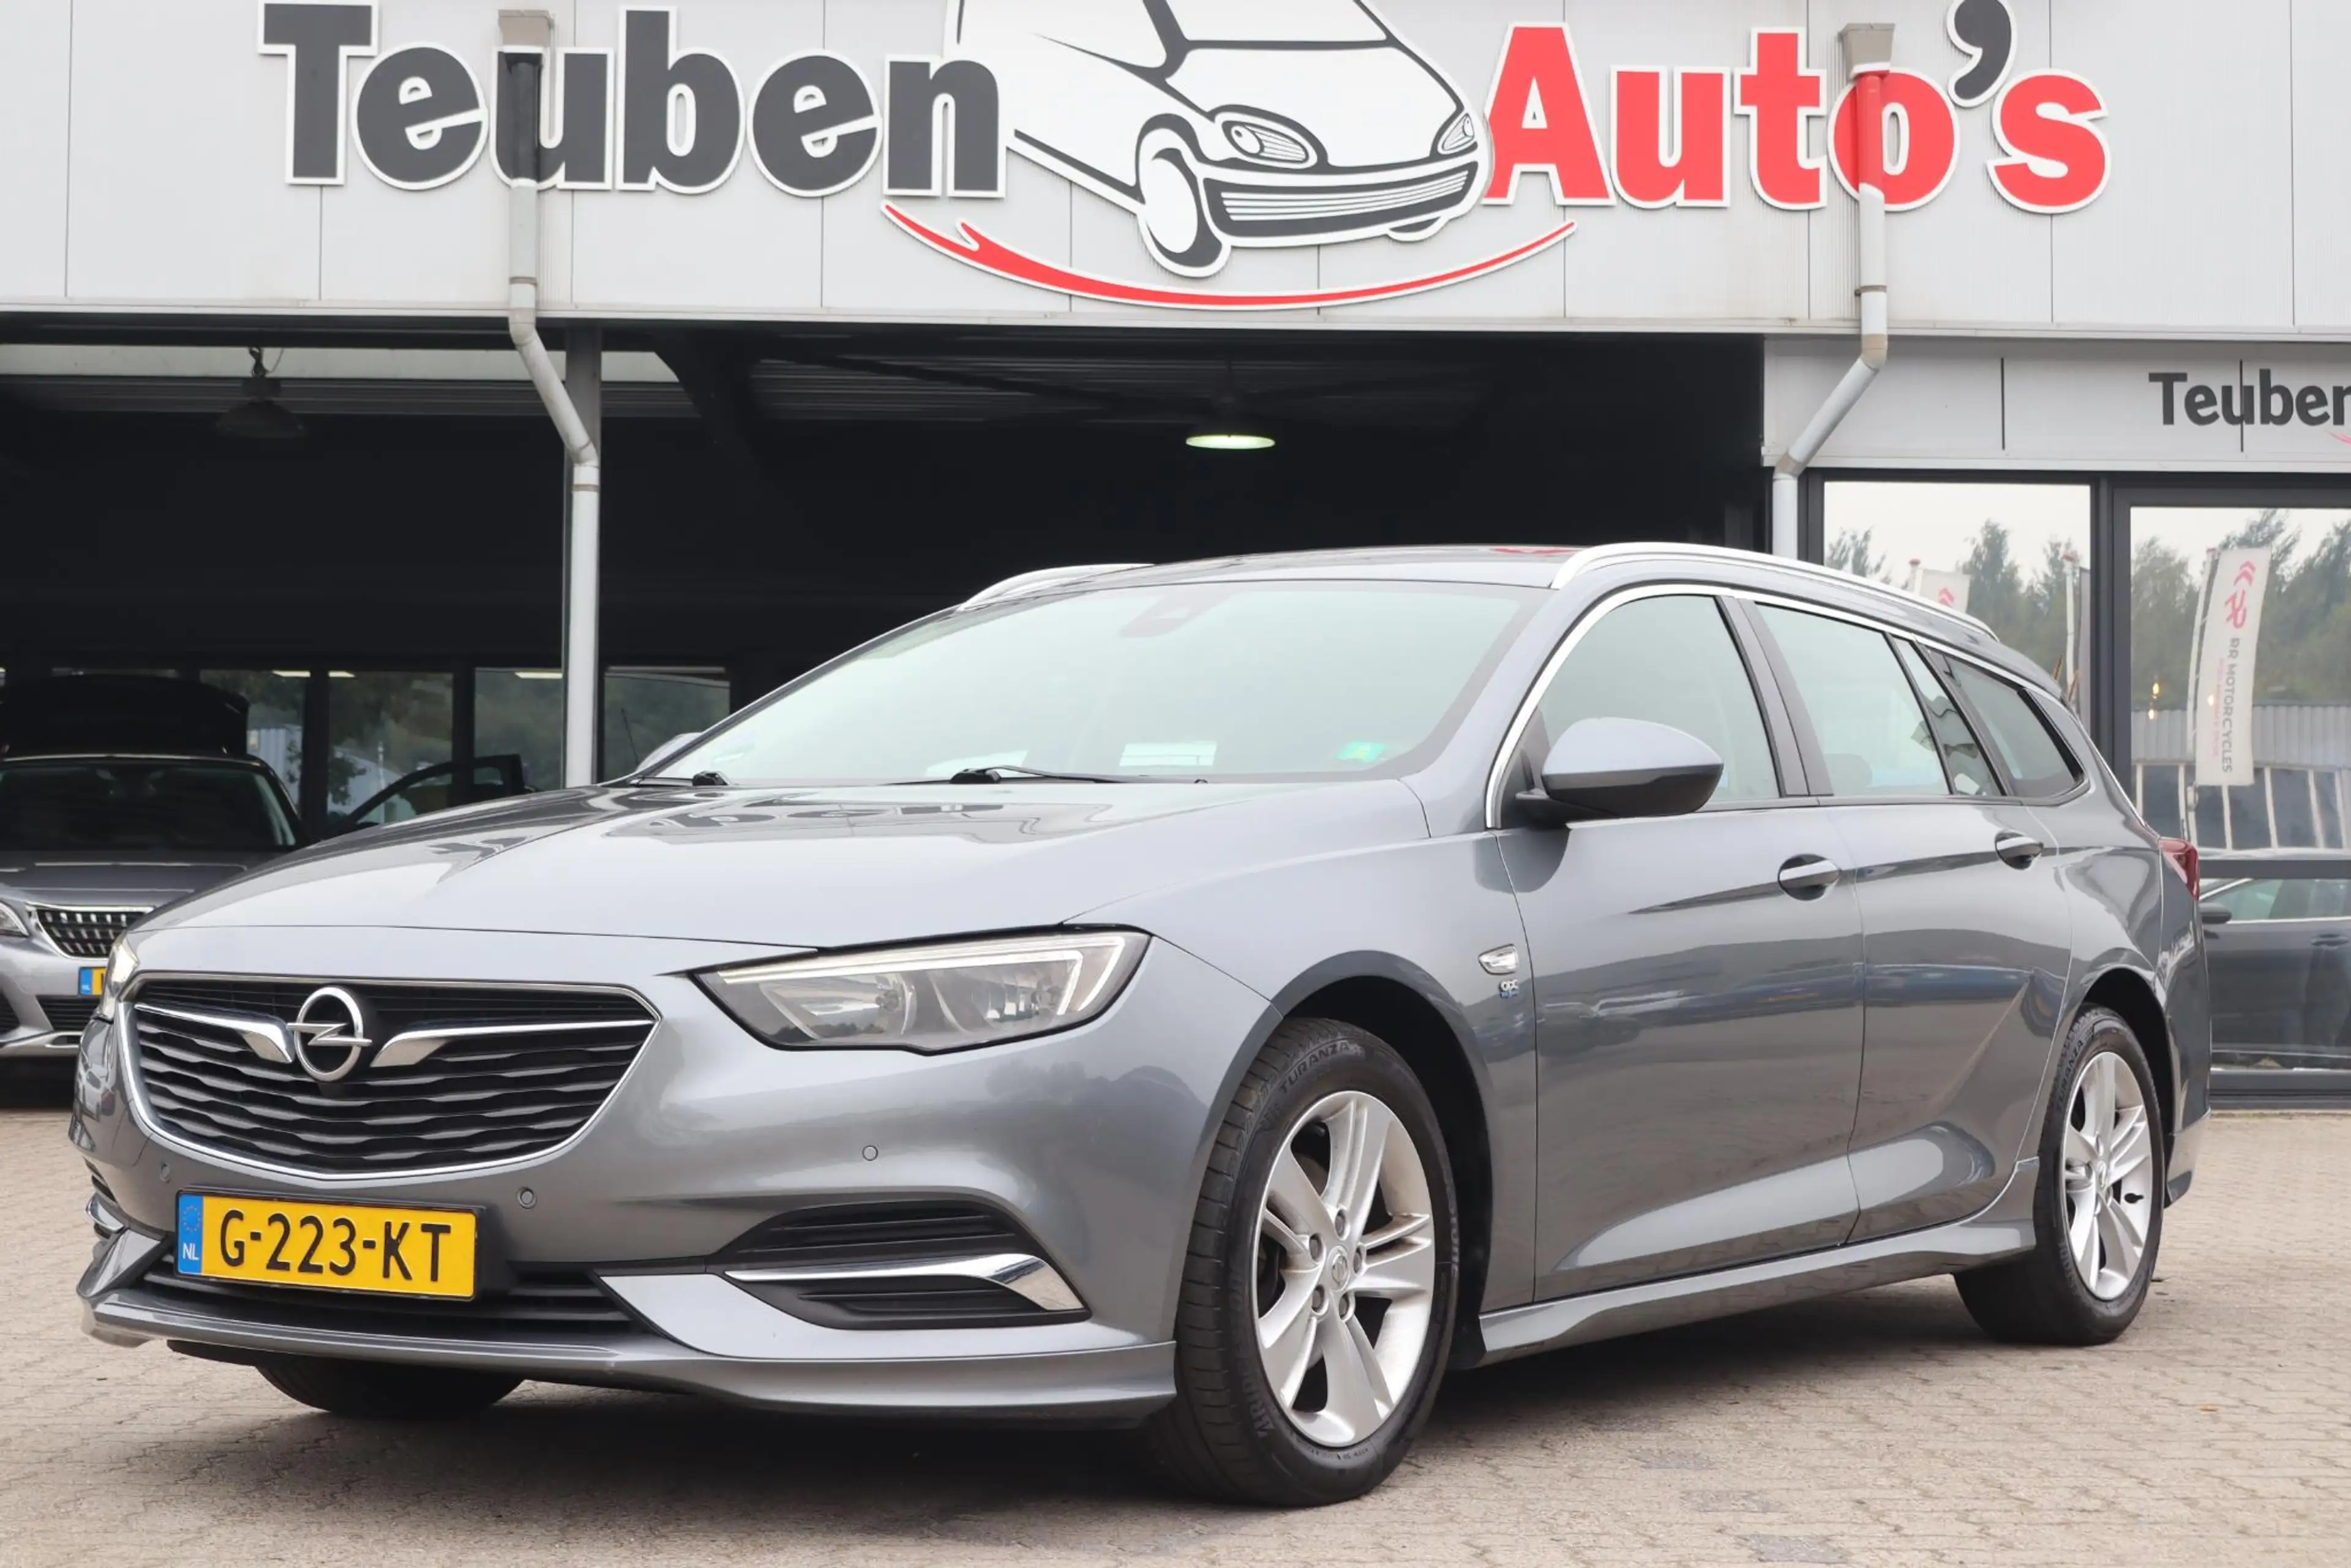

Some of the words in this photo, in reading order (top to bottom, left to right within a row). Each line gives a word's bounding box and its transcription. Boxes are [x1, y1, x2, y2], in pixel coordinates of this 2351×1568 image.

[258, 2, 1004, 198] Teuben
[1482, 0, 2109, 213] Auto's
[2222, 663, 2237, 773] MOTORCYCLES
[182, 1243, 199, 1261] NL
[220, 1209, 451, 1282] G-223-KT
